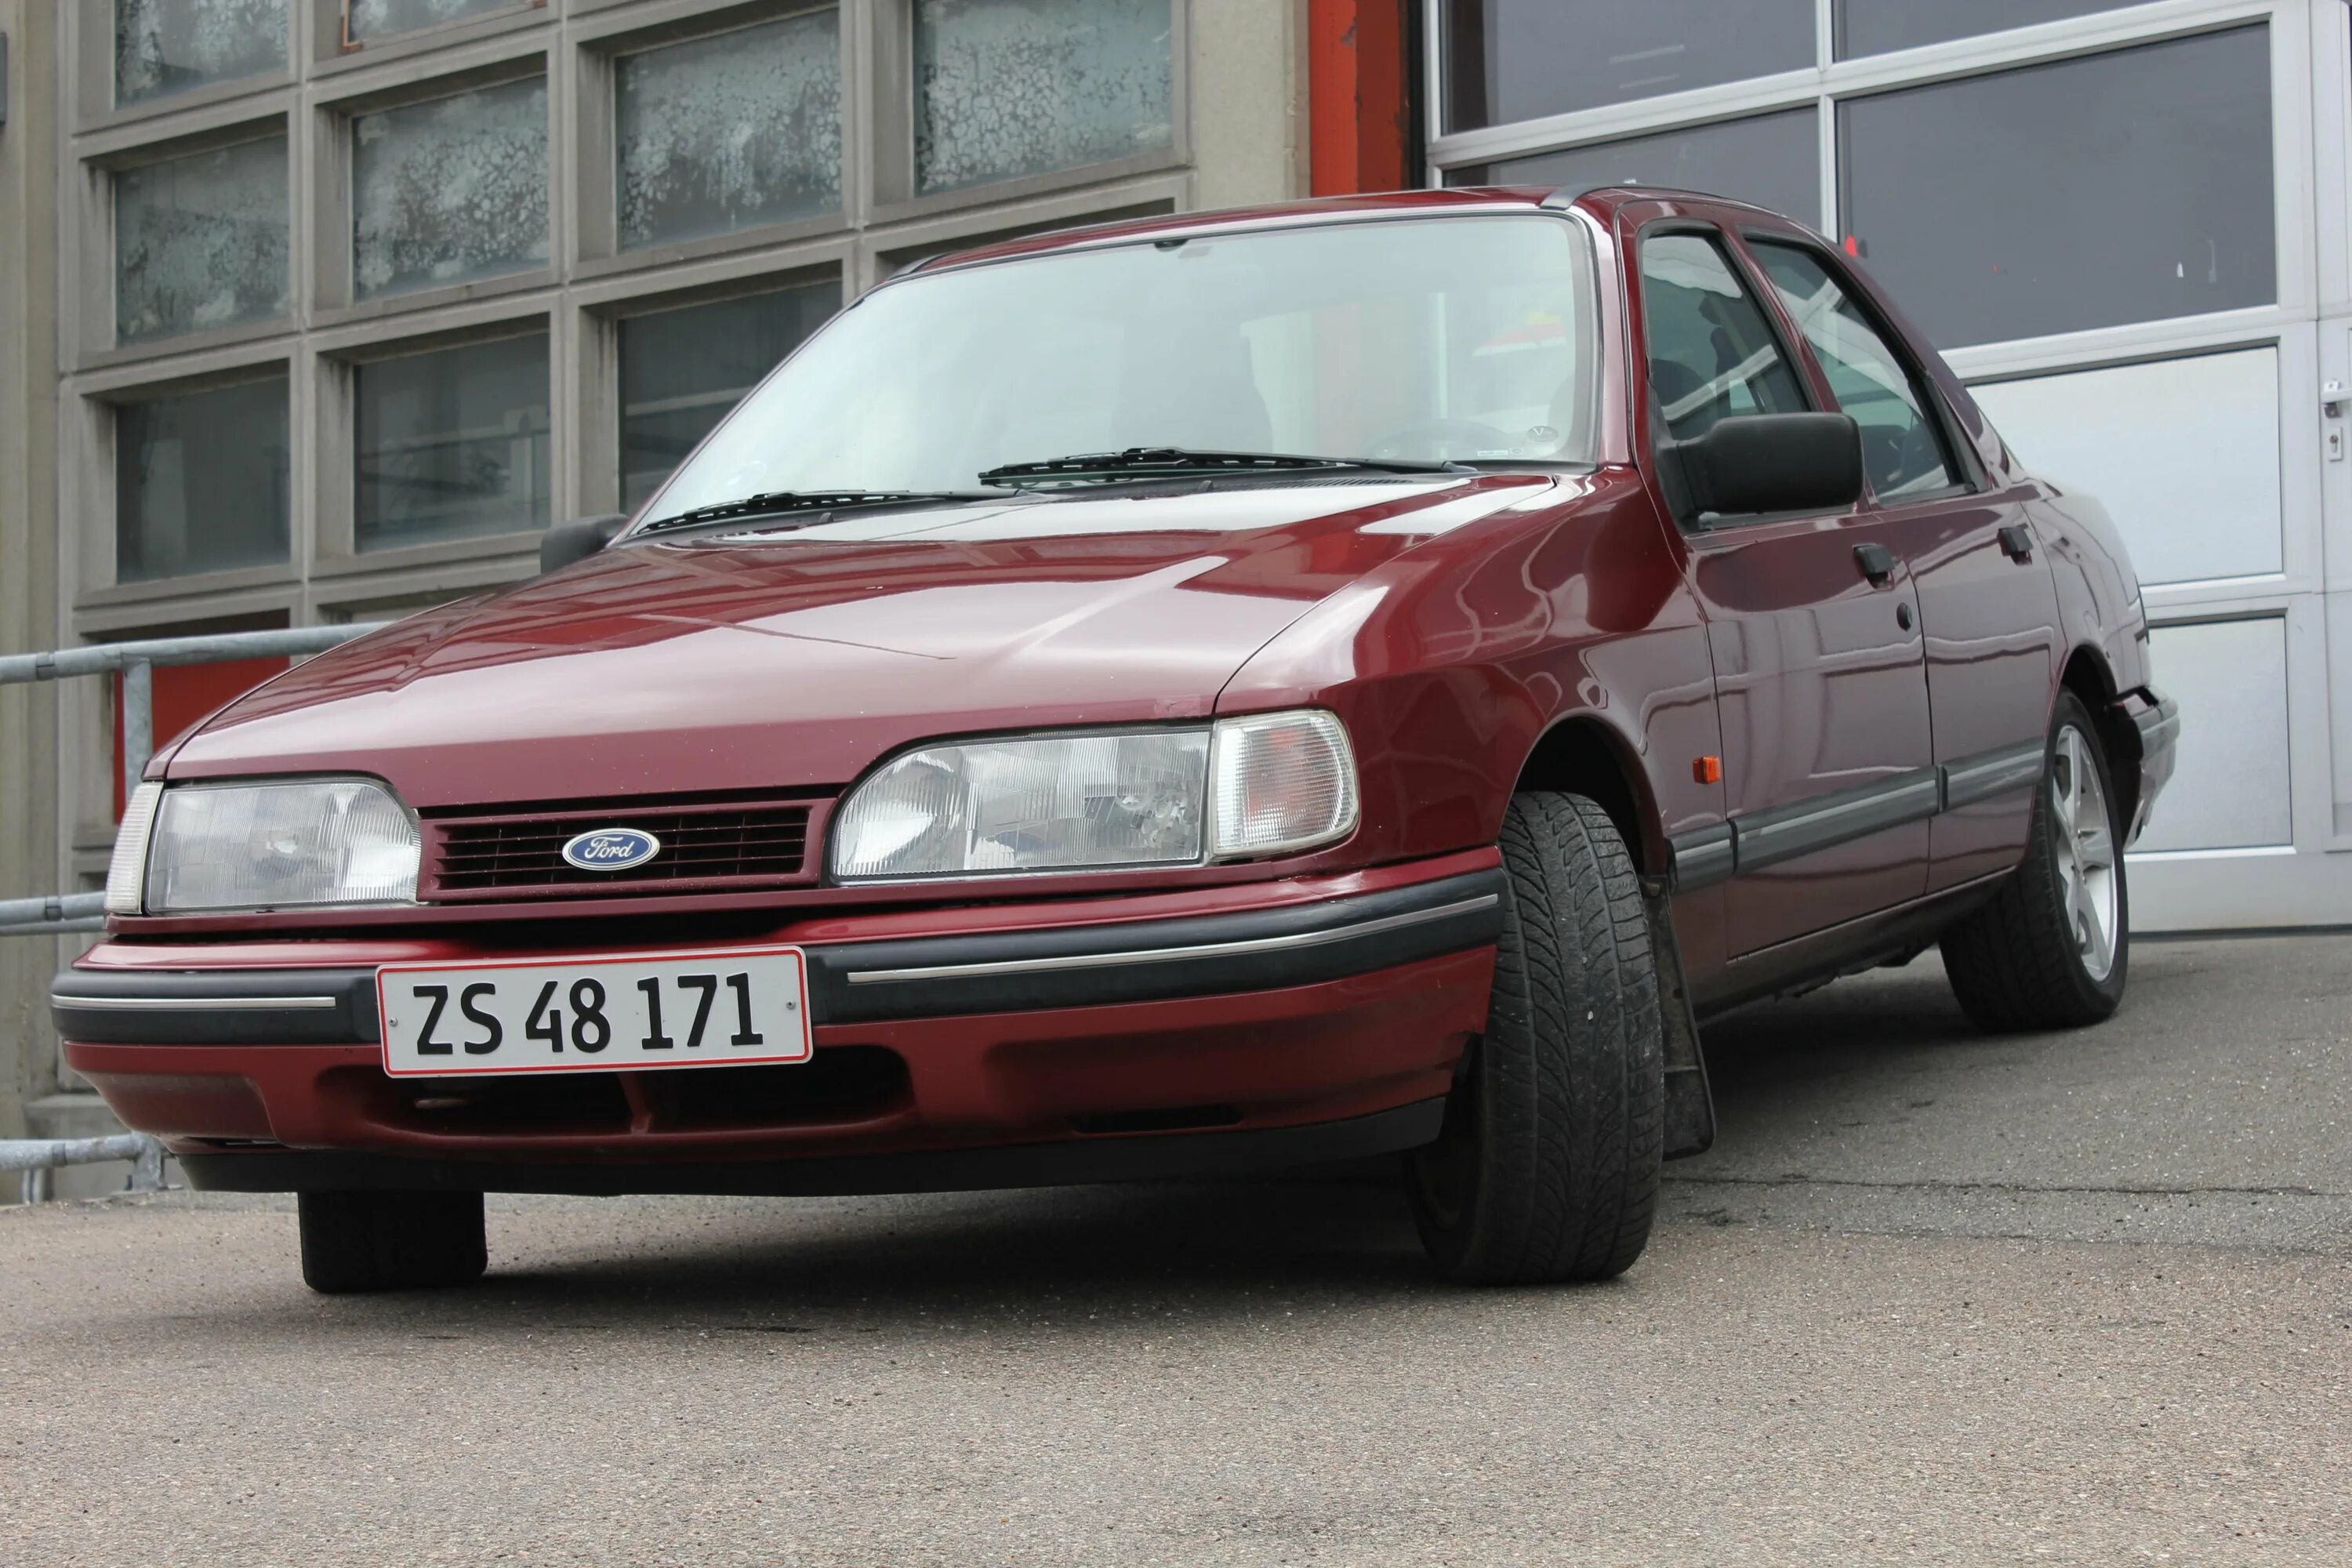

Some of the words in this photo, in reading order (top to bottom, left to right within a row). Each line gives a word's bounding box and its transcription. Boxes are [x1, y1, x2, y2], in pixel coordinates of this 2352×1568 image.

[584, 836, 635, 859] Ford
[413, 982, 503, 1055] ZS
[525, 978, 611, 1054] 48
[637, 972, 764, 1050] 171
